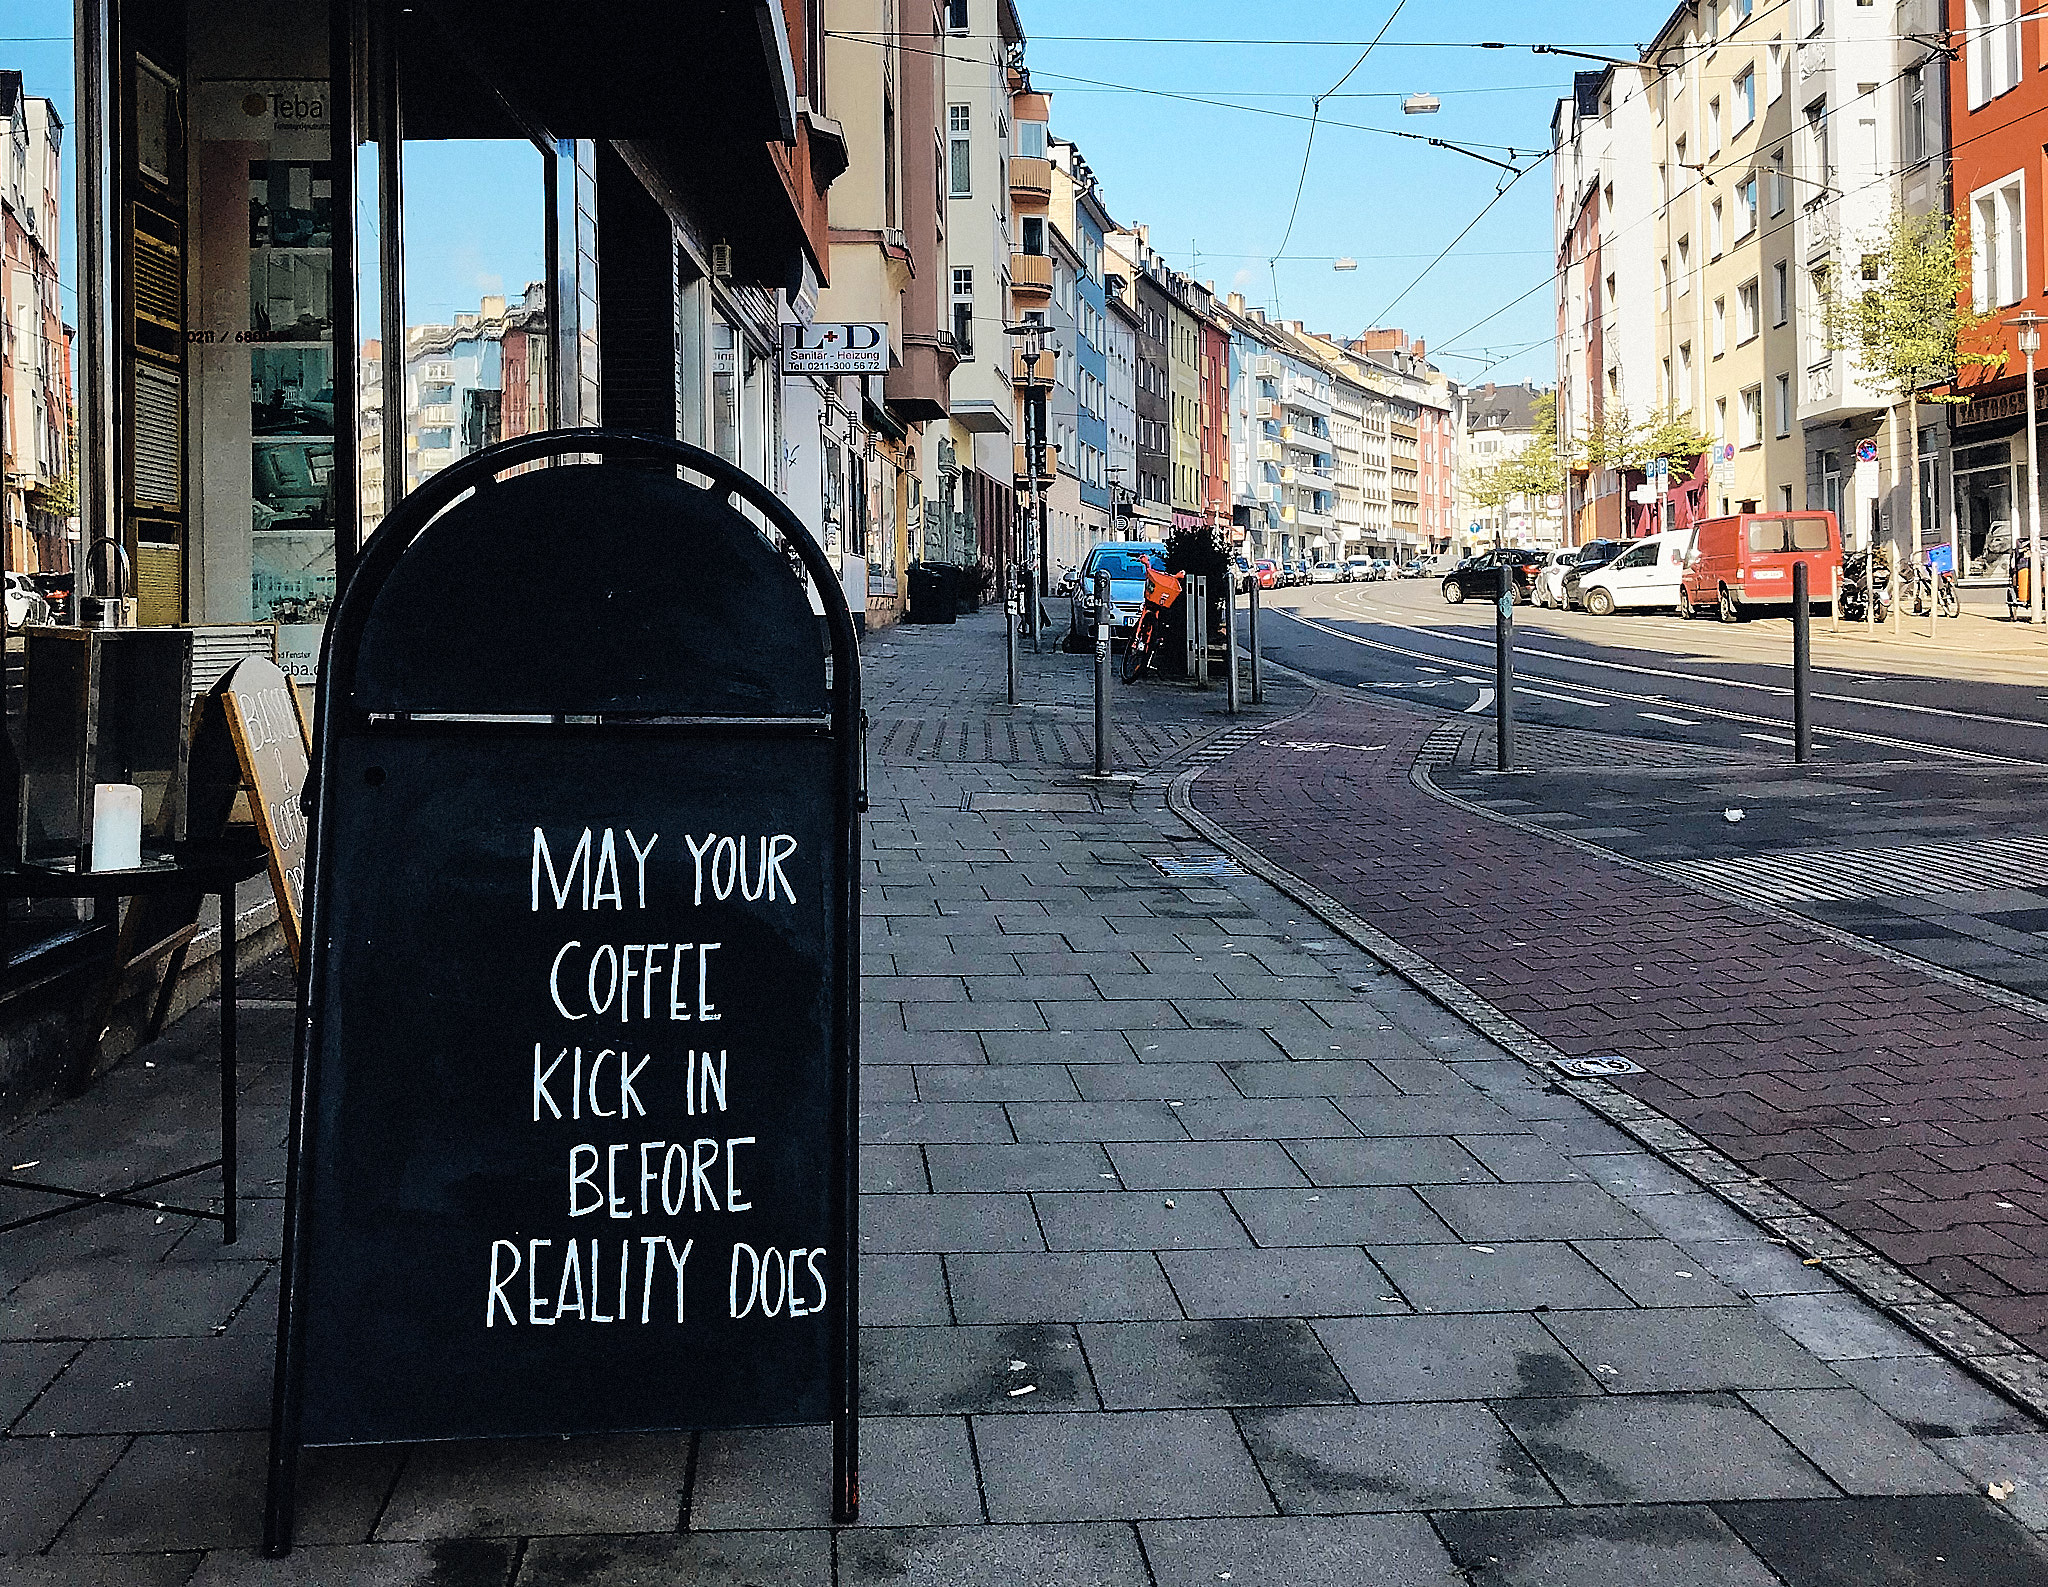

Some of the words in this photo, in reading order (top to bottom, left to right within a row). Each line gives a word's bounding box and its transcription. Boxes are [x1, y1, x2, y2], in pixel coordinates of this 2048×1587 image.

[788, 362, 805, 370] Tel.
[807, 361, 851, 370] 0211-300
[867, 361, 880, 370] 72
[837, 350, 880, 362] Heizung
[532, 827, 658, 911] MAY
[685, 833, 797, 906] YOUR
[550, 941, 721, 1022] COFFEE
[534, 1043, 650, 1121] KICK
[687, 1050, 727, 1115] IN
[568, 1137, 755, 1218] BEFORE
[487, 1236, 693, 1327] REALITY
[730, 1243, 826, 1318] DOES
